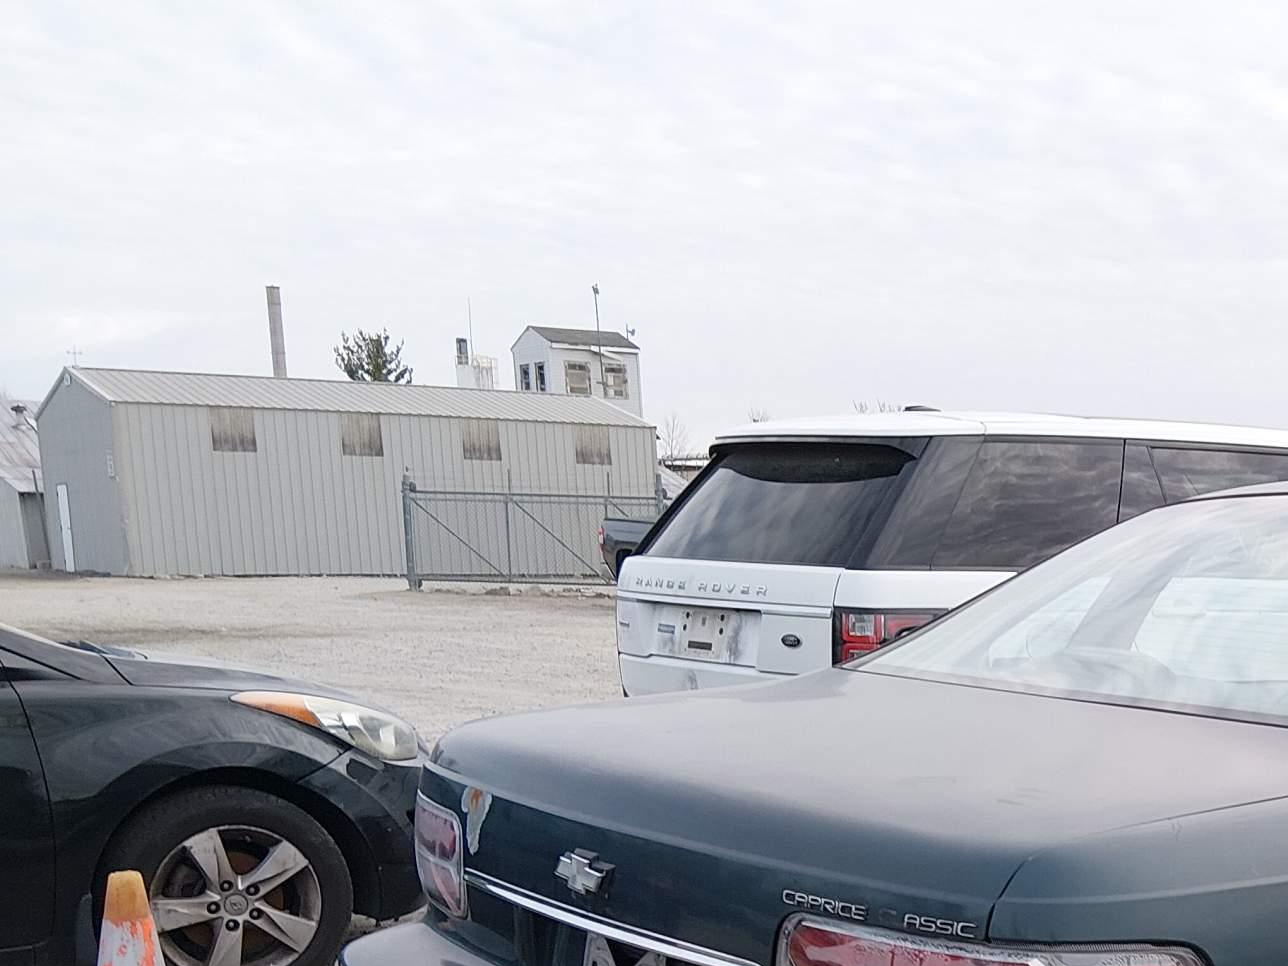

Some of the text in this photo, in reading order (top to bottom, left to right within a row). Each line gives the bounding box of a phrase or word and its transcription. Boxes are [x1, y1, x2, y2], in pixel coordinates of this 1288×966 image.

[635, 577, 768, 597] RANGE ROVER
[782, 889, 867, 921] CAPRICE
